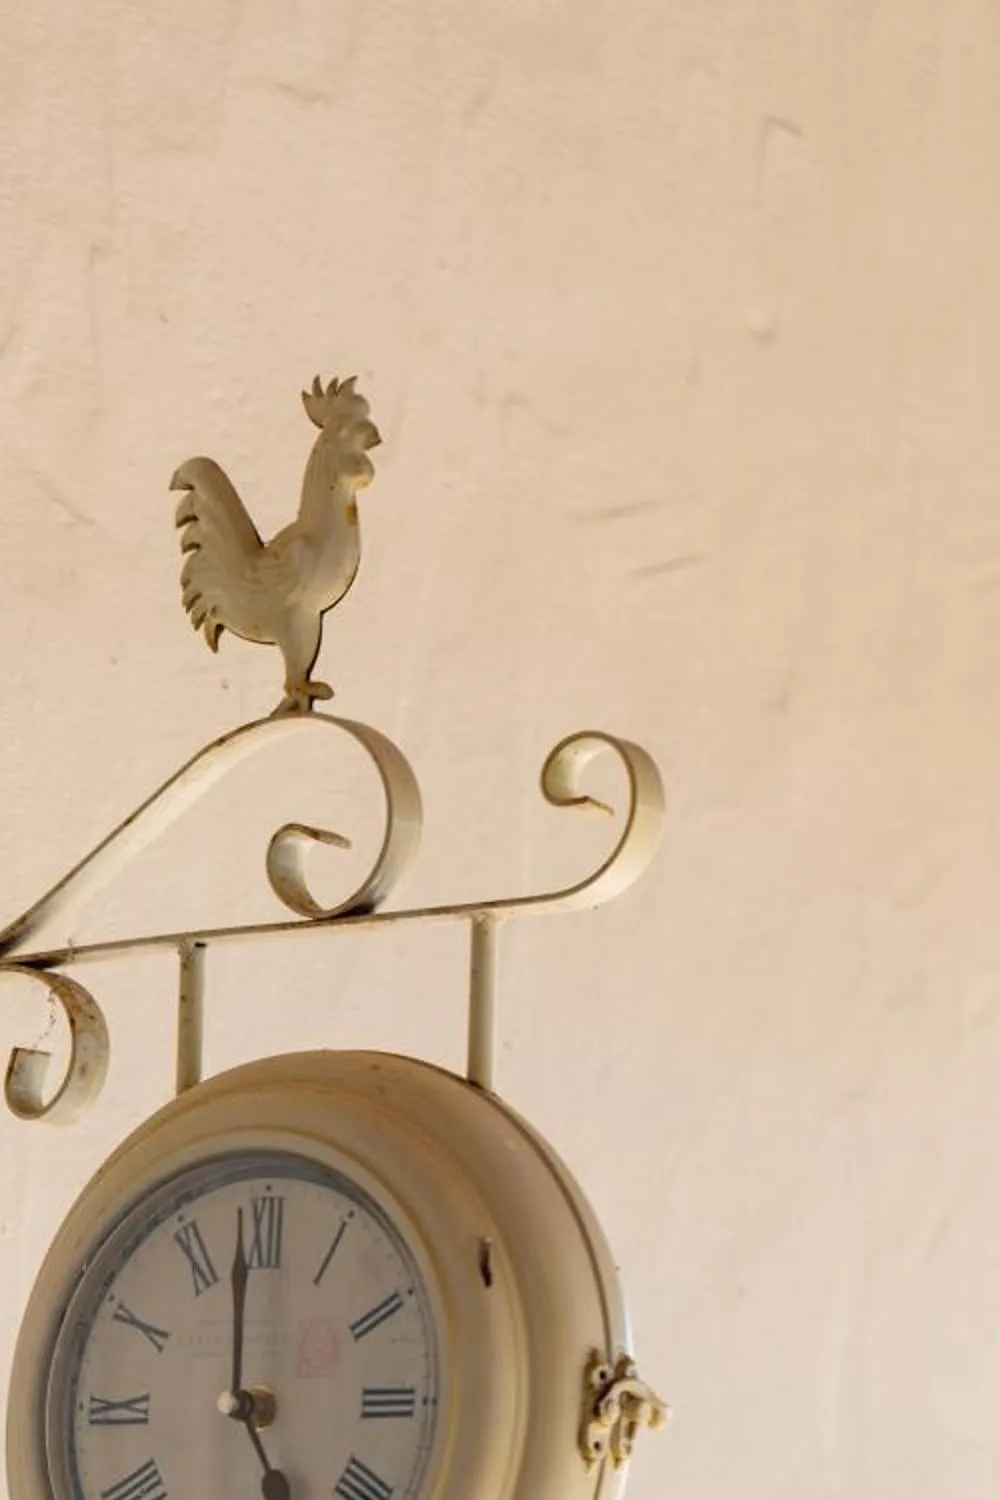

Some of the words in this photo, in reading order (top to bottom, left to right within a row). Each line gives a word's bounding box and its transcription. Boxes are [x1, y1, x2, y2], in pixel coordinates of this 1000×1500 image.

[248, 1196, 284, 1269] XII
[113, 1302, 170, 1353] X
[349, 1291, 403, 1341] II
[360, 1387, 415, 1418] III
